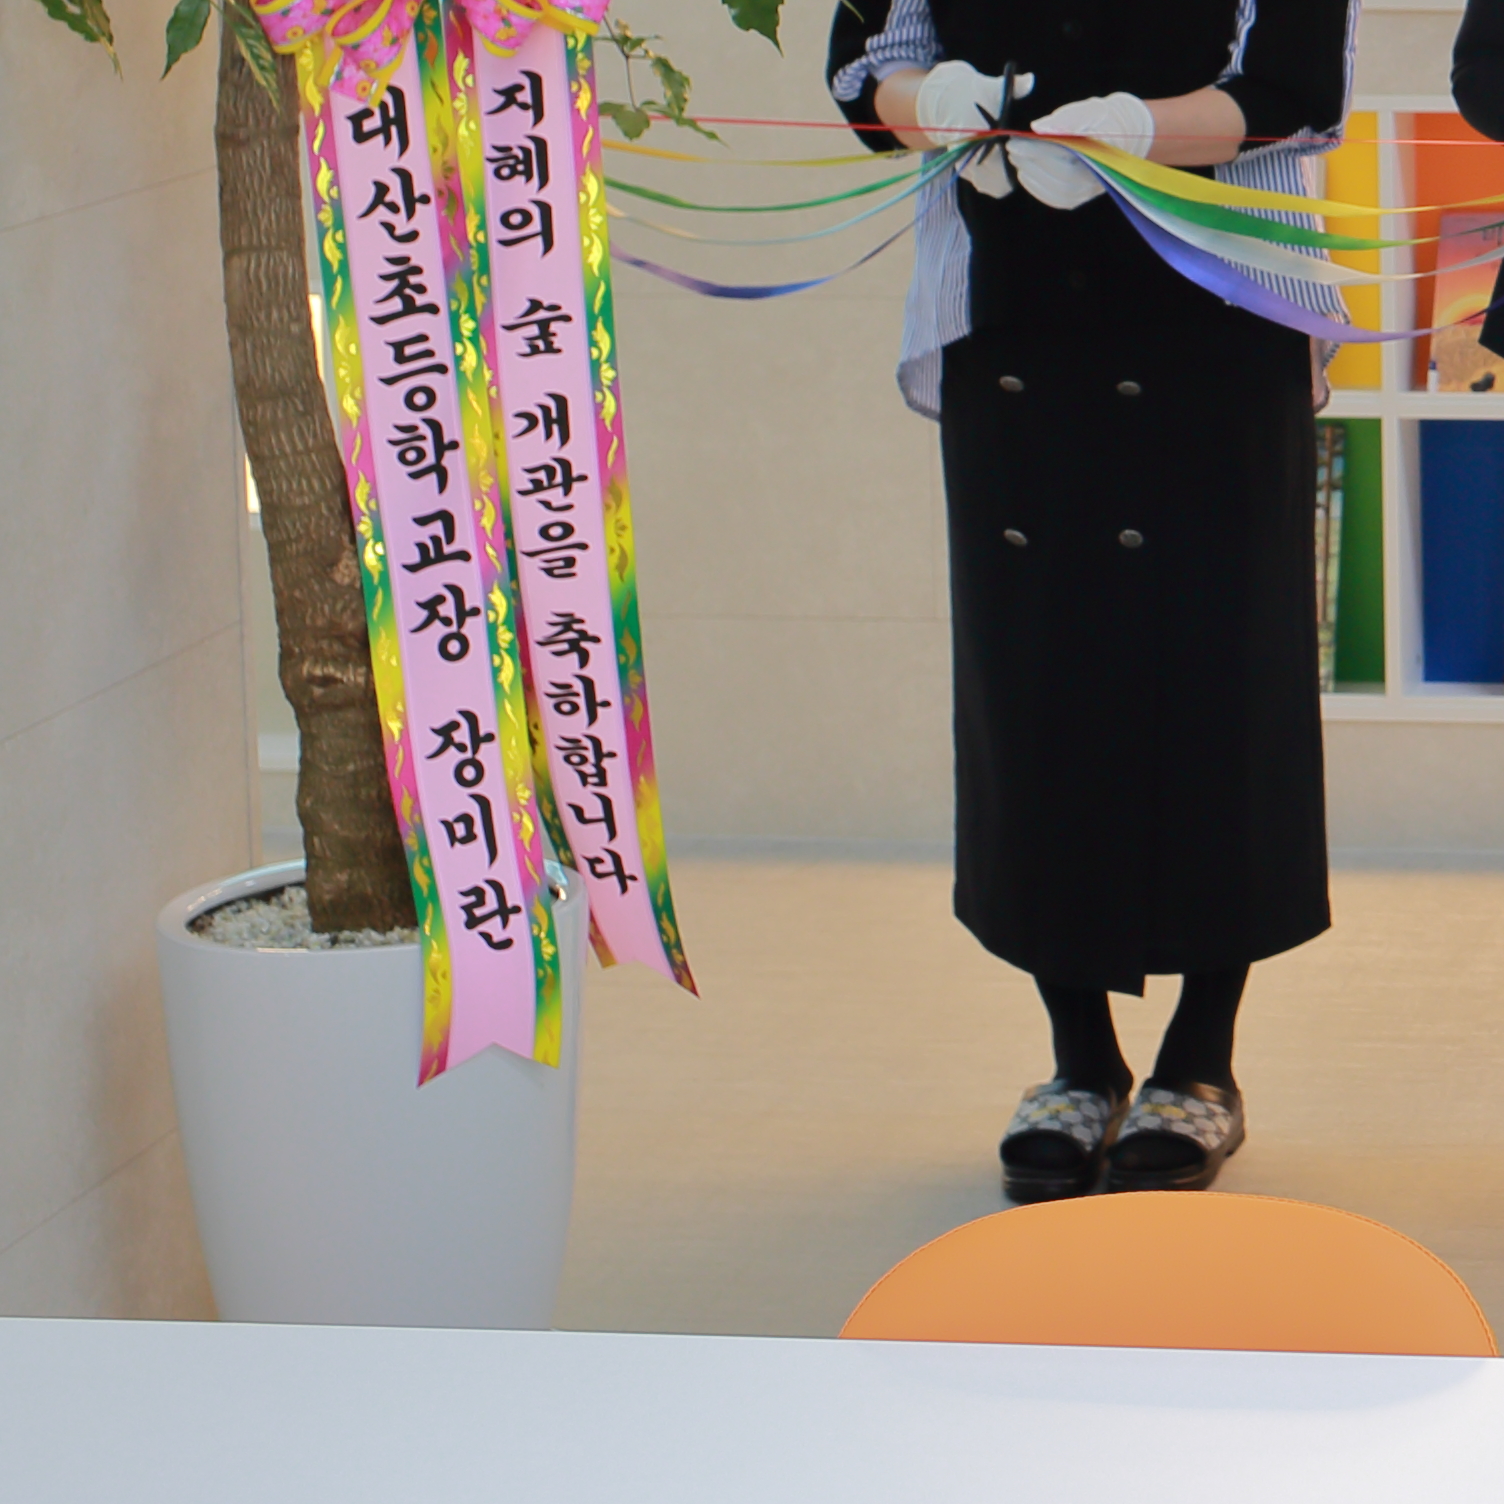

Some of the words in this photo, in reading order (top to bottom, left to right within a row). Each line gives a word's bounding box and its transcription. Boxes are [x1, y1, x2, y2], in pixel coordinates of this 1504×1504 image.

[485, 69, 555, 258] 지혜의
[500, 296, 573, 359] 숲
[345, 83, 482, 663] 대산초등학교장
[426, 709, 523, 951] 장미란
[511, 391, 590, 579] 개관을
[535, 610, 639, 897] 축하합니다
